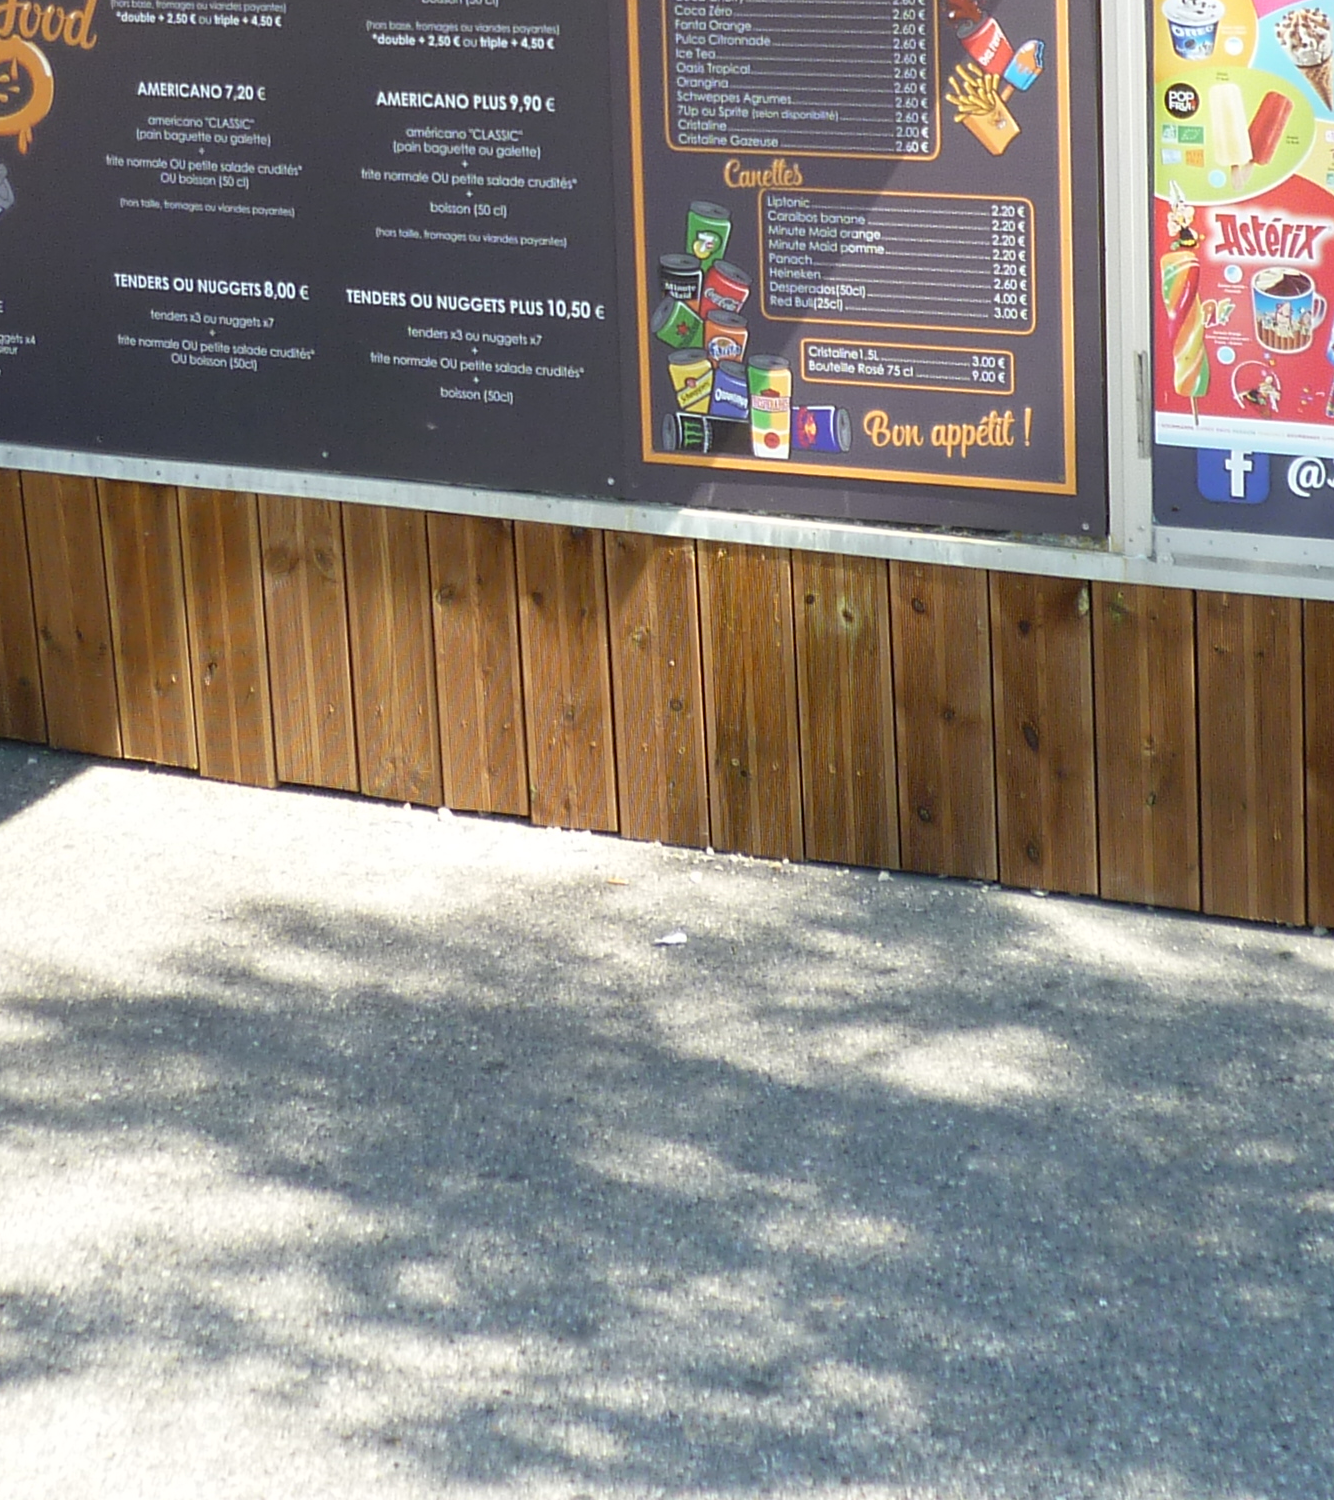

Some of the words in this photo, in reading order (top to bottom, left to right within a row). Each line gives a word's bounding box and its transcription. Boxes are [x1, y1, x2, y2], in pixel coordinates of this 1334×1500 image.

[674, 18, 705, 32] Fanta
[708, 19, 753, 34] Orange
[1171, 24, 1214, 38] OREO
[136, 81, 223, 101] AMERICANO
[224, 84, 255, 104] 7,20
[255, 86, 268, 102] €
[376, 90, 471, 111] AMERICANO
[472, 93, 507, 111] PLUS
[508, 94, 543, 115] 9,90
[544, 96, 556, 113] €
[676, 91, 741, 107] Schweppes
[743, 92, 793, 108] Agrumes
[1168, 90, 1195, 102] POP
[724, 158, 804, 189] Canettes
[767, 224, 805, 240] Minute
[808, 225, 839, 241] Maid
[840, 228, 882, 245] orange
[1214, 213, 1327, 260] Astérix
[769, 267, 822, 282] Heineken
[113, 273, 171, 292] TENDERS
[172, 276, 195, 294] OU
[196, 277, 262, 299] NUGGETS
[263, 280, 296, 303] 8,00
[298, 283, 310, 301] €
[346, 288, 408, 309] TENDERS
[410, 292, 434, 311] OU
[436, 294, 507, 316] NUGGETS
[508, 299, 545, 318] PLUS
[546, 298, 592, 321] 10,50
[593, 303, 606, 321] €
[808, 360, 856, 376] Bouteille
[856, 360, 886, 377] Rosé
[887, 365, 902, 378] 75
[902, 364, 915, 378] cl
[863, 408, 924, 449] Bon
[930, 407, 1016, 459] appétit
[1023, 406, 1033, 447] !
